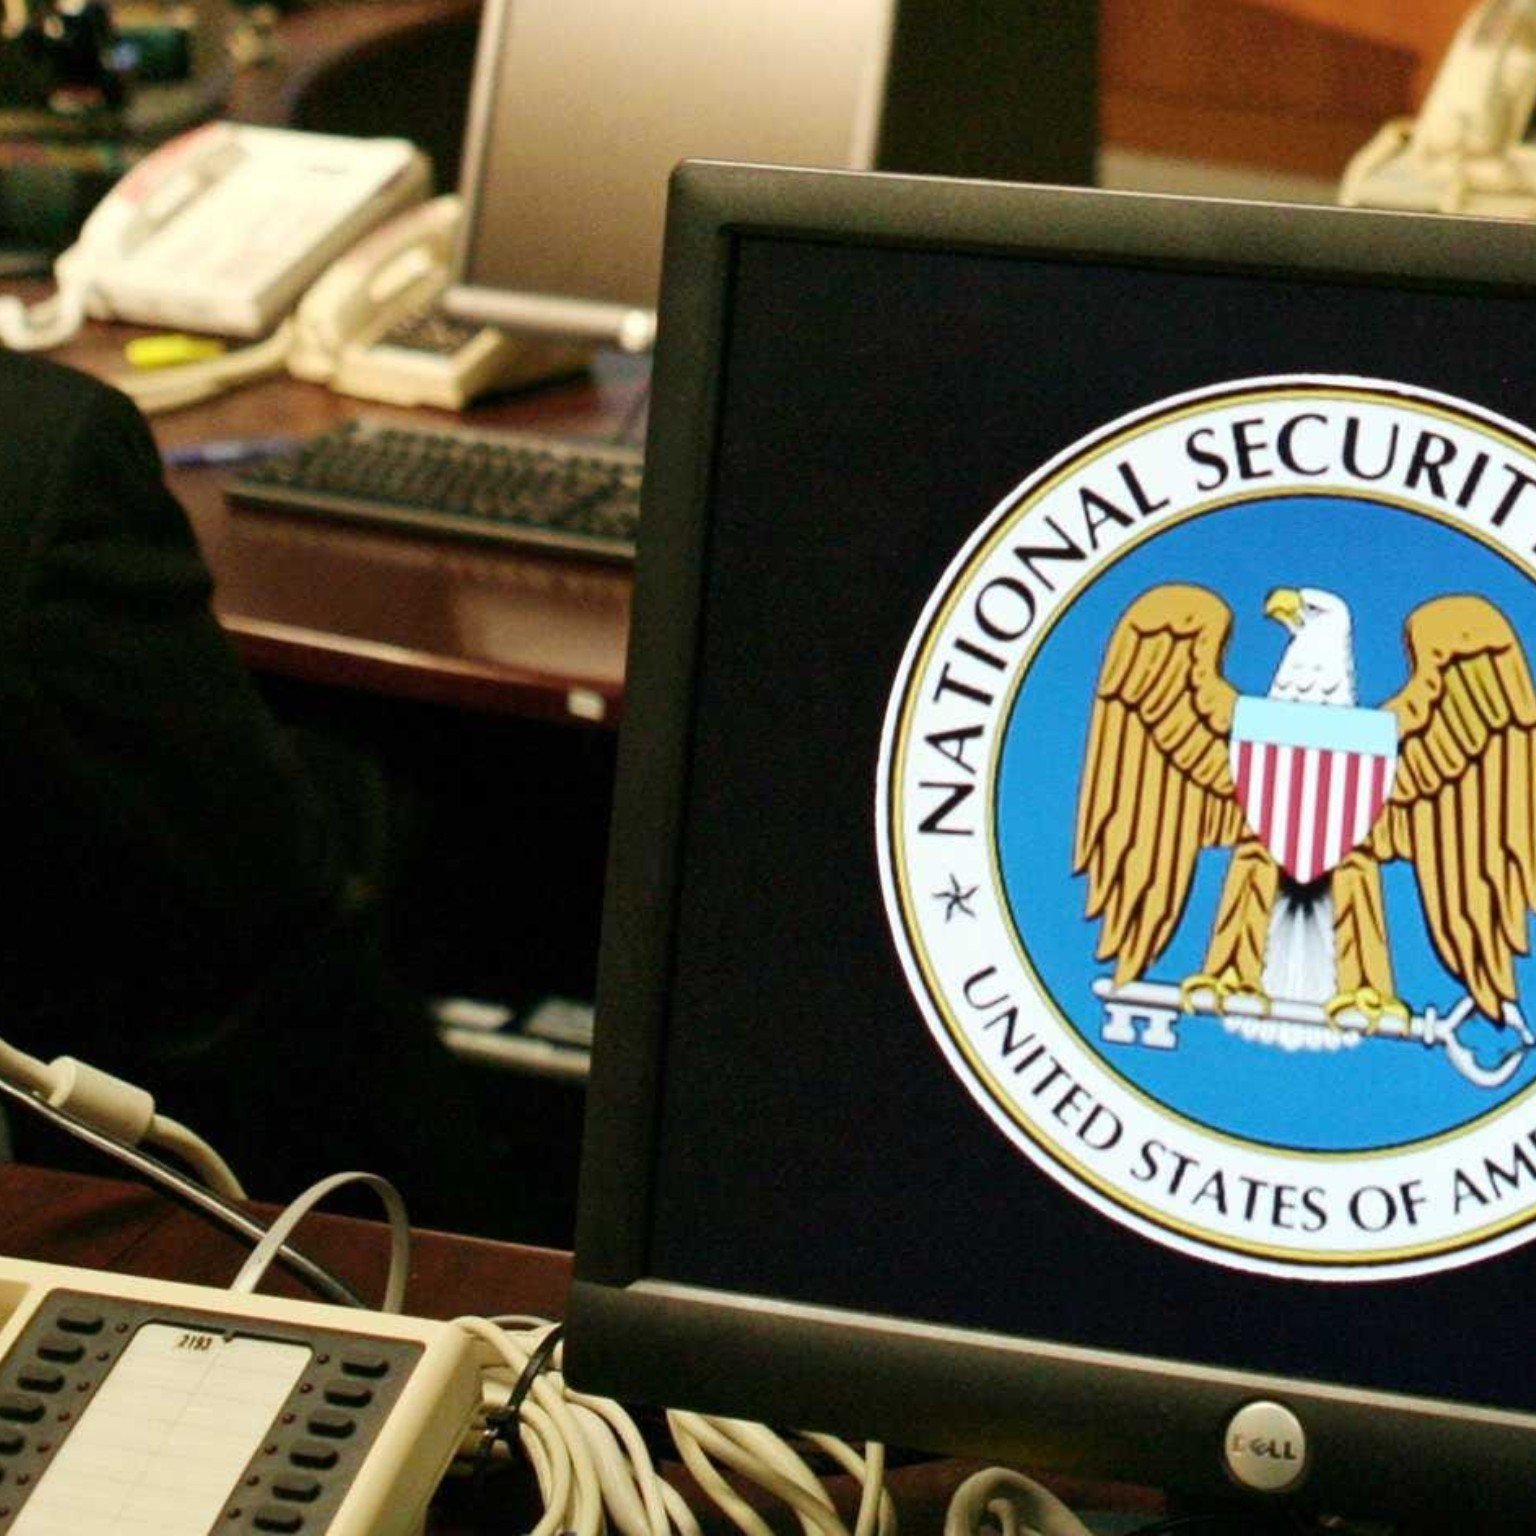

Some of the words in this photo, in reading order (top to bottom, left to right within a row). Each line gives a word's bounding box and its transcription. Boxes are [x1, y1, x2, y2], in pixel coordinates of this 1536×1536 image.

[918, 462, 1170, 836] NATIONAL
[961, 964, 1123, 1152] UNITED
[1129, 1140, 1329, 1232] STATES
[1348, 1180, 1429, 1233] OF
